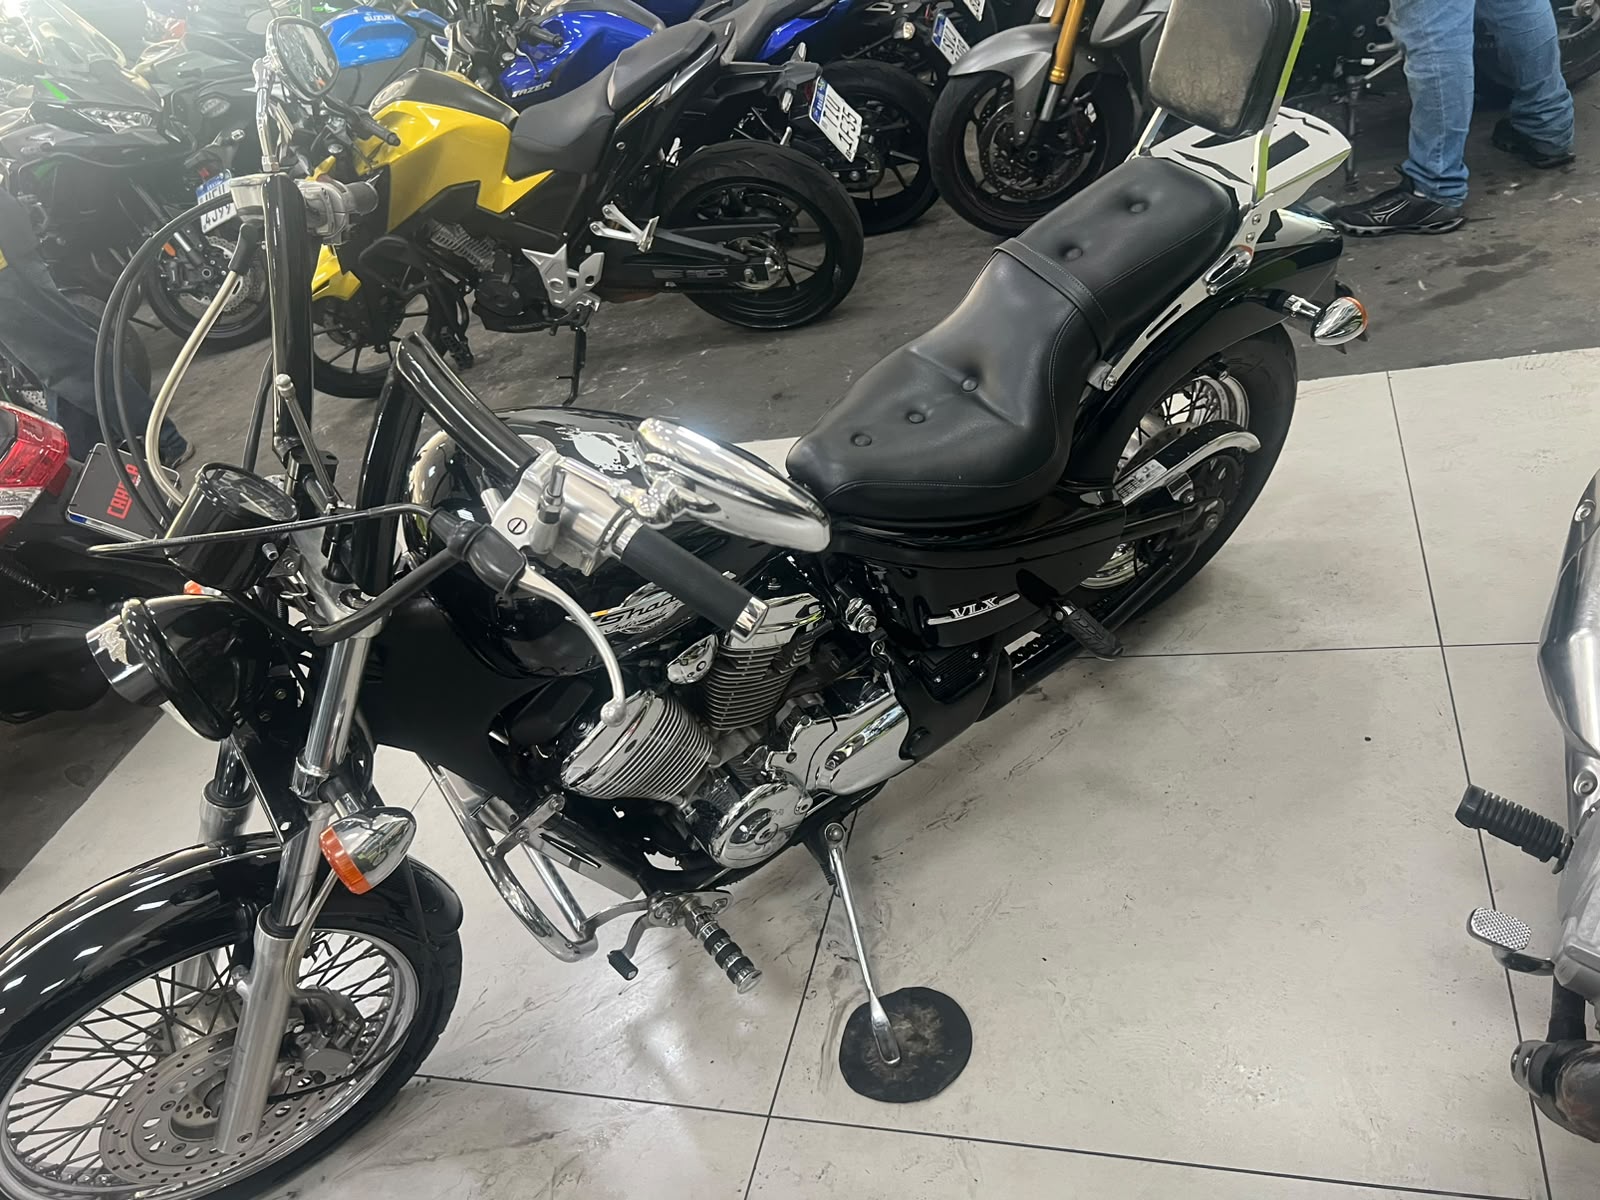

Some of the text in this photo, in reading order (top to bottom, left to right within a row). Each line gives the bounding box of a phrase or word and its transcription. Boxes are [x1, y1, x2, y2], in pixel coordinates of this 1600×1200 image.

[511, 80, 553, 98] FAZER
[823, 94, 841, 128] TIU
[838, 106, 858, 151] 1F35
[949, 595, 999, 620] VLX
